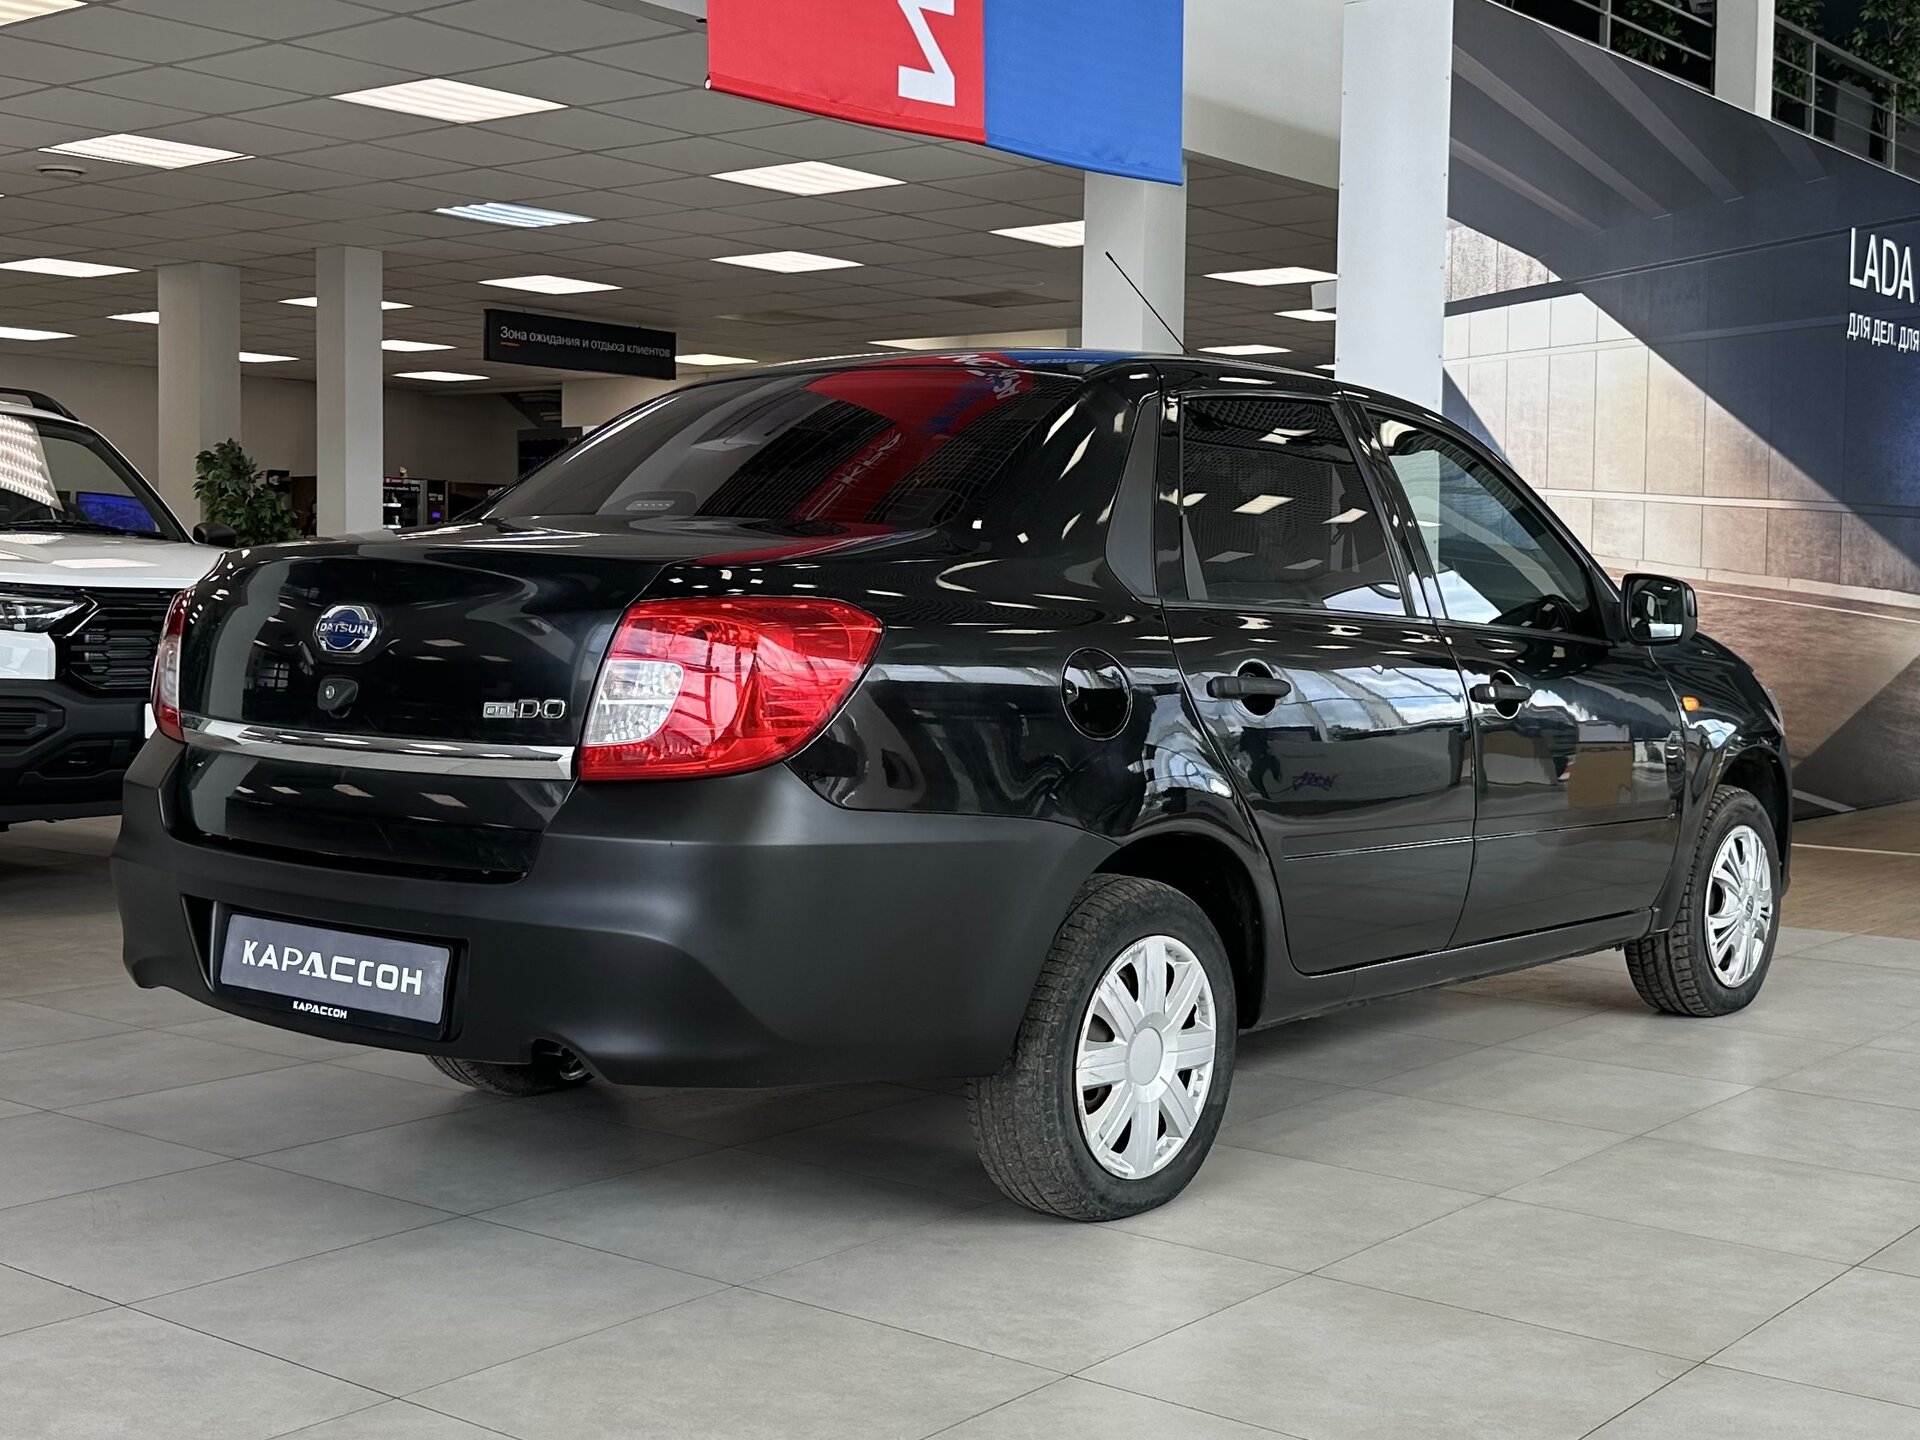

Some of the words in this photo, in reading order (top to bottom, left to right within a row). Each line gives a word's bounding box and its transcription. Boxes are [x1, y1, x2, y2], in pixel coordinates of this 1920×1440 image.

[1849, 227, 1914, 304] LADA
[500, 325, 527, 341] Зона
[529, 332, 580, 347] ожидания
[582, 339, 589, 348] и
[590, 340, 625, 353] отдыха
[626, 343, 671, 358] клиентов
[319, 621, 371, 635] DATSUN
